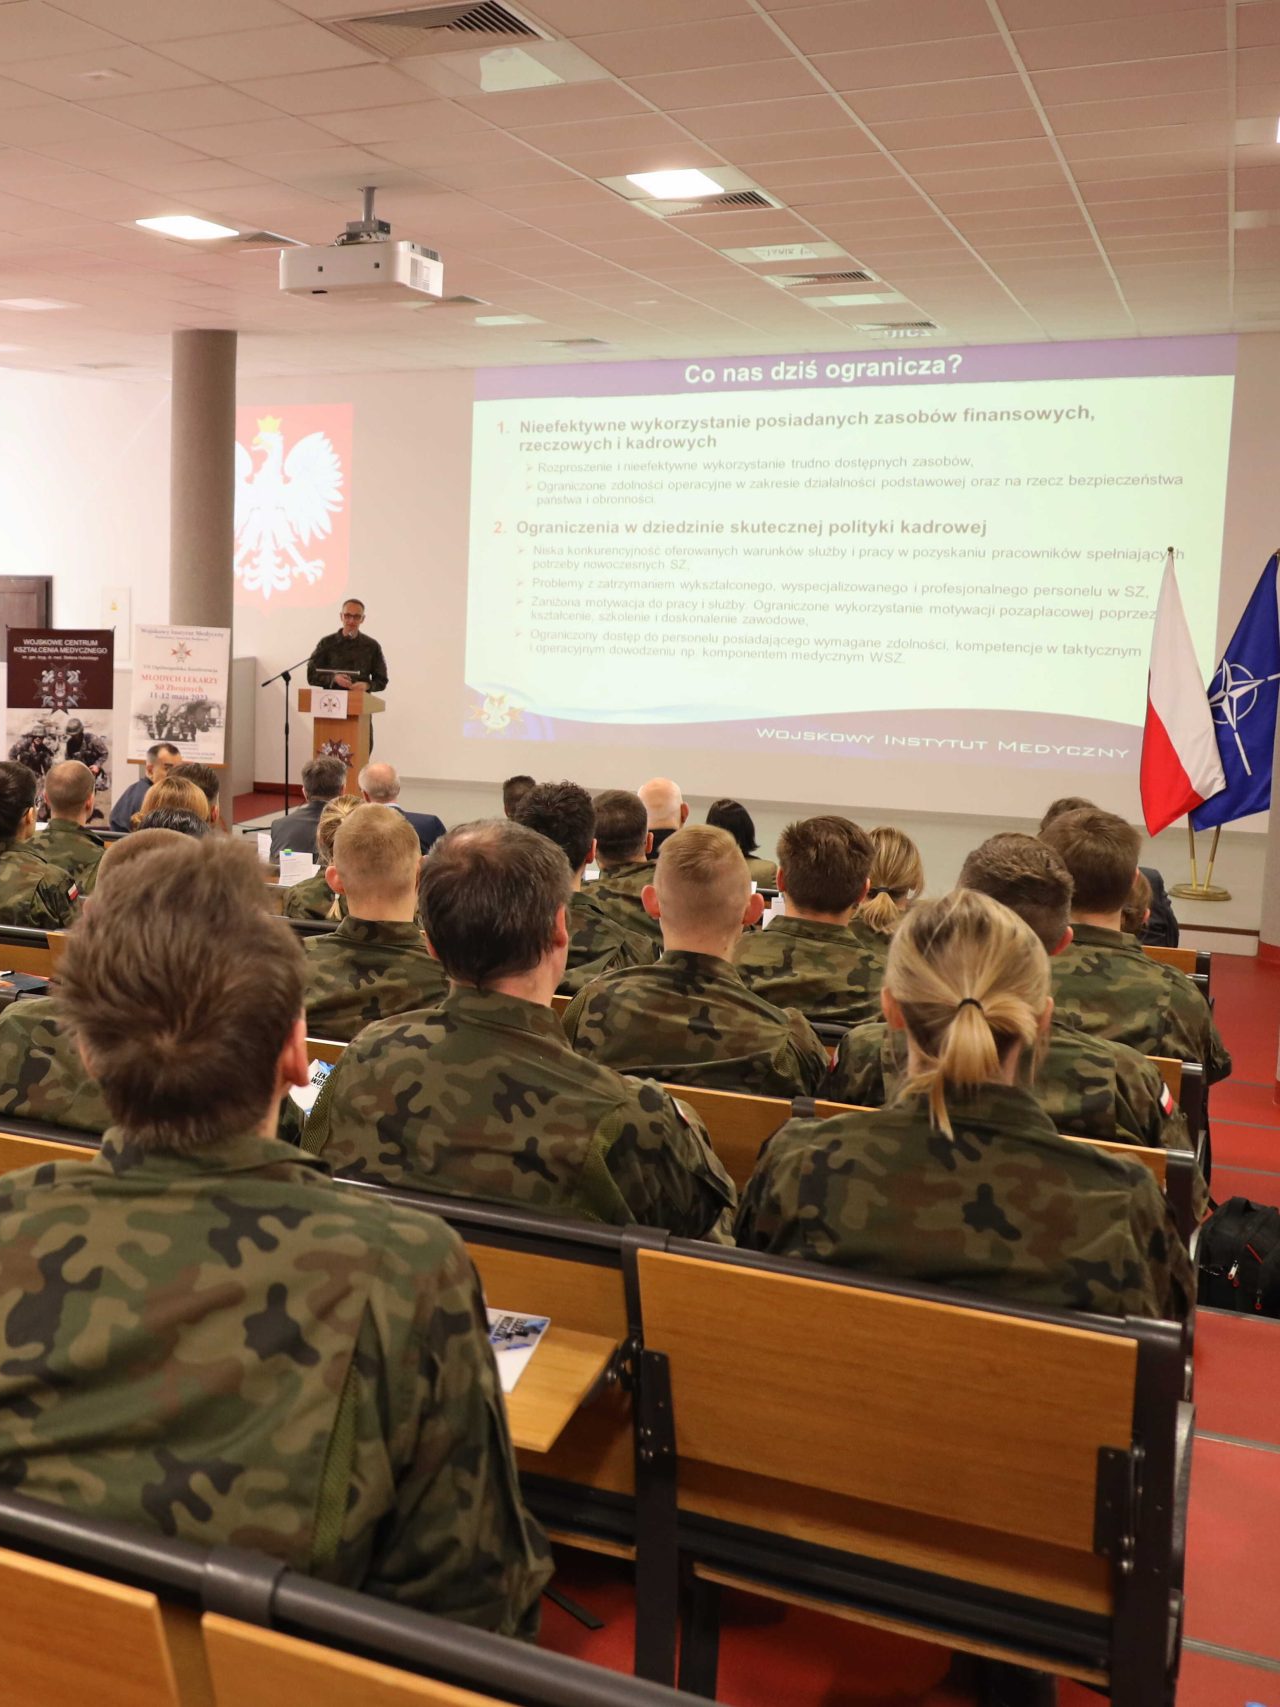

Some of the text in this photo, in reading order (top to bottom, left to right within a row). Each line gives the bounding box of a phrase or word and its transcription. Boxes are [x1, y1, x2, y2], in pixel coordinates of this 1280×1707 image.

[685, 354, 962, 384] Co nas dziś ogranicza?
[520, 420, 626, 435] Nieefektywne
[631, 415, 751, 432] wykorzystanie
[756, 412, 868, 430] posiadanych
[874, 408, 957, 425] zasobów
[964, 404, 1095, 425] finansowych,
[520, 435, 717, 453] rzeczowych i kadrowych
[538, 460, 612, 473] Rozproszenie
[617, 461, 620, 471] i
[624, 459, 697, 472] nieefektywne
[703, 458, 785, 471] wykorzystanie
[791, 457, 830, 469] trudno
[835, 457, 907, 471] dostępnych
[537, 473, 1183, 493] Ograniczone zdolności operacyjne w zakresie działalności podstawowej oraz na rzecz bezpieczeństwa
[537, 494, 582, 507] państwa
[587, 494, 589, 504] i
[517, 520, 619, 536] Ograniczenia
[625, 523, 637, 534] w
[642, 520, 724, 534] dziedzinie
[730, 519, 822, 536] skutecznej
[829, 519, 893, 536] polityki
[901, 519, 986, 537] kadrowej
[533, 544, 564, 556] Niska
[568, 543, 660, 558] konkurencyjność
[665, 545, 738, 558] oferowanych
[743, 545, 803, 557] warunków
[808, 544, 847, 559] służby
[852, 546, 855, 556] i
[859, 547, 893, 560] pracy
[898, 549, 908, 557] w
[913, 547, 986, 560] pozyskaniu
[992, 547, 1081, 560] pracowników
[533, 557, 579, 571] potrzeby
[584, 558, 665, 571] nowoczesnych
[532, 577, 583, 590] Problemy
[588, 580, 594, 589] z
[598, 579, 675, 591] zatrzymaniem
[781, 580, 908, 594] wyspecjalizowanego
[914, 583, 917, 593] i
[921, 583, 1028, 597] profesjonalnego
[1034, 585, 1102, 597] personelu
[1108, 588, 1119, 597] w
[532, 596, 581, 608] Zaniżona
[586, 597, 644, 610] motywacja
[649, 598, 661, 608] do
[666, 599, 697, 612] pracy
[702, 598, 705, 609] i
[753, 599, 829, 613] Ograniczone
[835, 602, 923, 615] wykorzystanie
[930, 603, 995, 617] motywacji
[1099, 608, 1156, 621] poprzez
[599, 611, 650, 622] szkolenie
[655, 612, 658, 622] i
[661, 612, 737, 624] doskonalenie
[530, 629, 597, 642] Ograniczony
[602, 630, 640, 643] dostęp
[644, 631, 658, 642] do
[662, 632, 719, 644] personelu
[723, 633, 810, 647] posiadającego
[814, 636, 881, 649] wymagane
[955, 639, 1042, 654] kompetencje
[1046, 643, 1057, 653] w
[1062, 642, 1141, 657] taktycznym
[529, 644, 532, 652] i
[536, 643, 604, 657] operacyjnym
[609, 644, 676, 657] dowodzeniu
[702, 648, 787, 661] komponentem
[791, 650, 864, 663] medycznym
